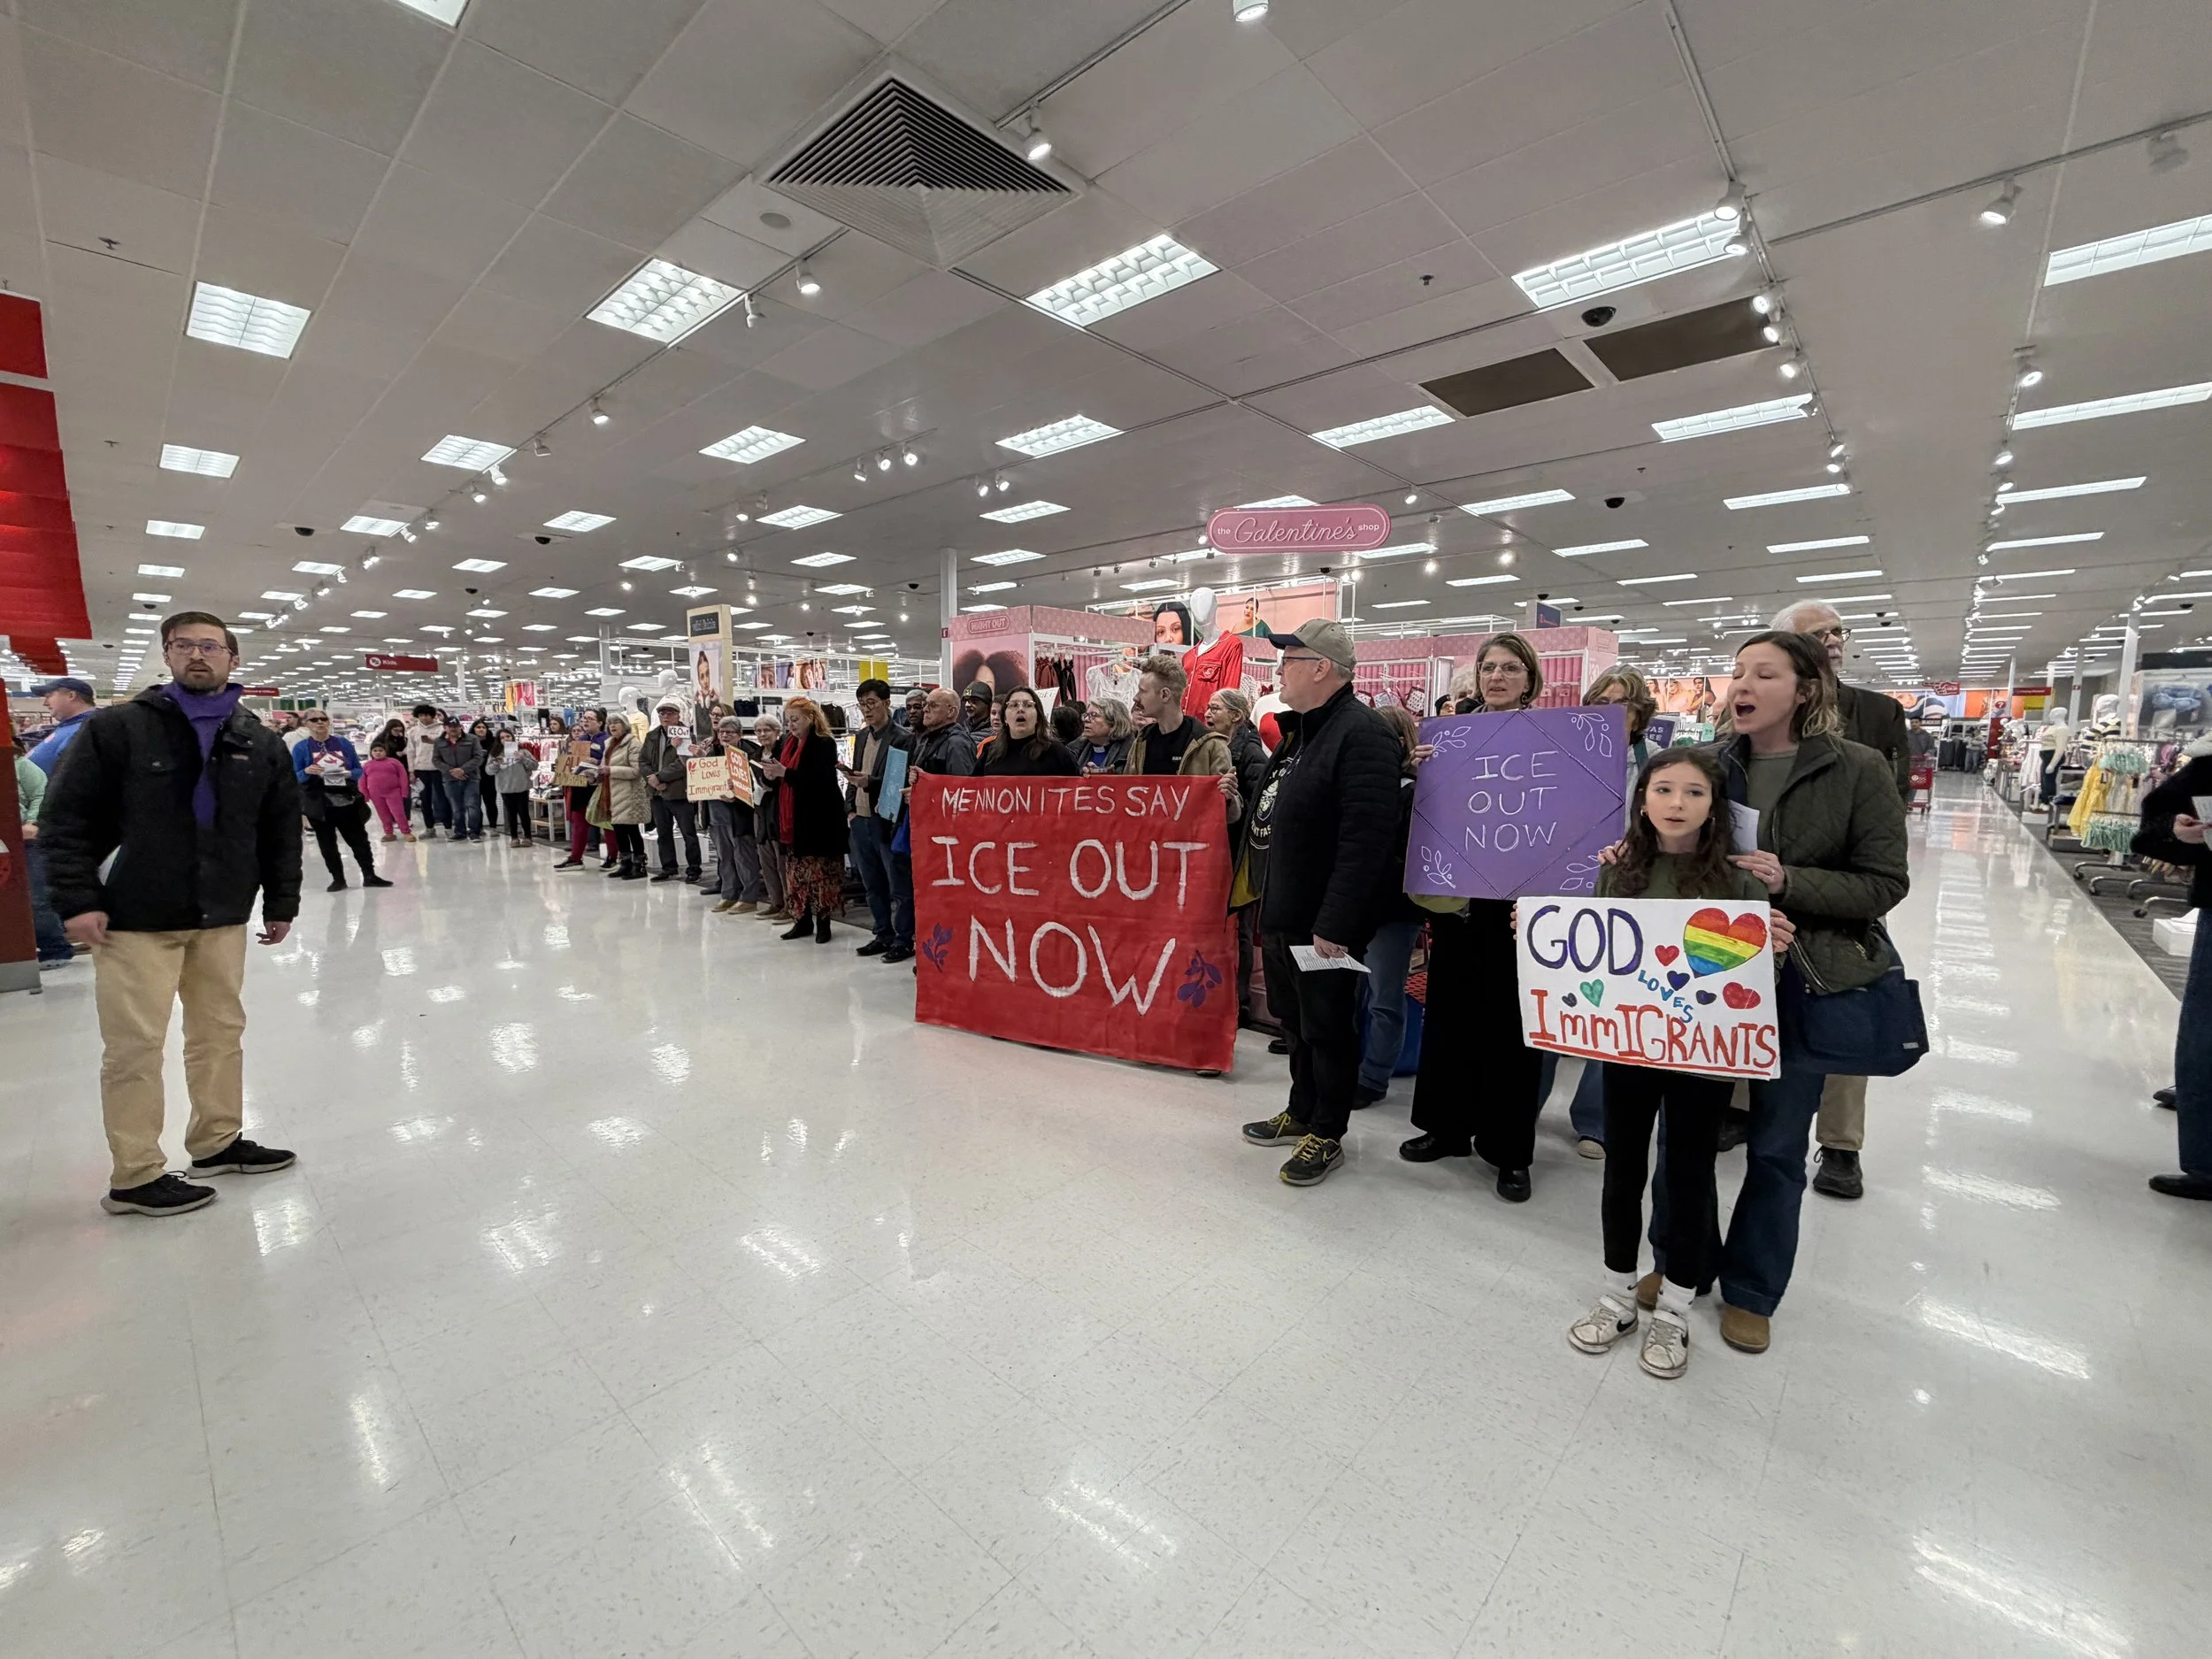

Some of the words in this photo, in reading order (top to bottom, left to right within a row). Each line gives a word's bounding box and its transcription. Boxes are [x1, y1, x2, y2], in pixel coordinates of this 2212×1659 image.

[1234, 518, 1357, 543] Galentine's
[1358, 523, 1379, 532] shop
[992, 618, 1006, 628] OUT
[698, 757, 718, 769] God
[1471, 750, 1559, 780] ICE
[687, 780, 728, 796] Immigrant
[941, 785, 1116, 819] MENNONITES
[1125, 784, 1190, 821] SAY
[1467, 786, 1558, 816] OUT
[1464, 821, 1557, 852] NOW
[931, 836, 1040, 896] ICE
[1069, 839, 1210, 912] OUT
[1526, 904, 1644, 976] GOD
[969, 914, 1176, 1017] NOW
[1637, 970, 1694, 1024] LOVES
